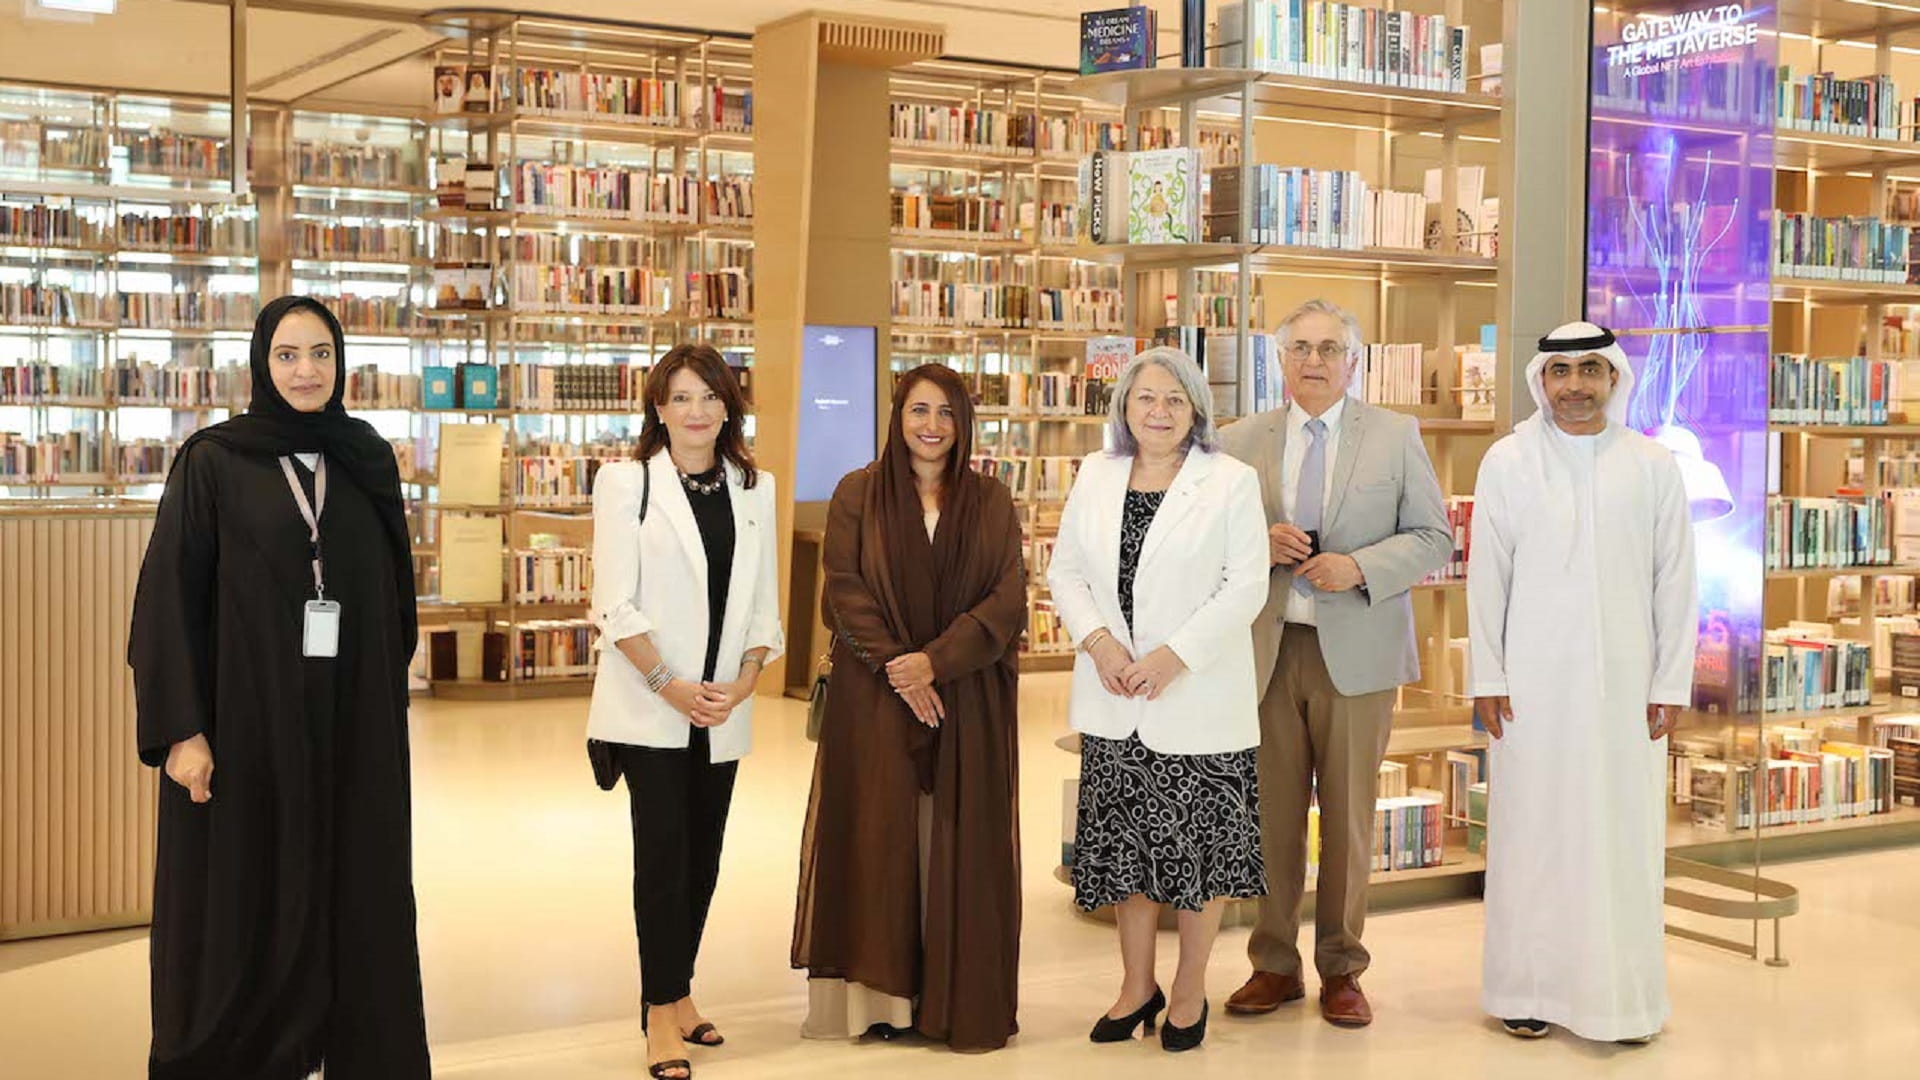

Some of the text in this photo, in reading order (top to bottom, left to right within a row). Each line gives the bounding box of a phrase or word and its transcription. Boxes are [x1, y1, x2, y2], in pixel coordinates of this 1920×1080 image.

[1088, 23, 1139, 38] MEDICINE
[1622, 4, 1743, 42] GATEWAY TO
[1607, 23, 1758, 67] THE METAVERSE
[1623, 67, 1631, 78] A
[1632, 63, 1660, 76] Global
[1661, 59, 1680, 72] NFT
[1092, 195, 1103, 235] PICKS
